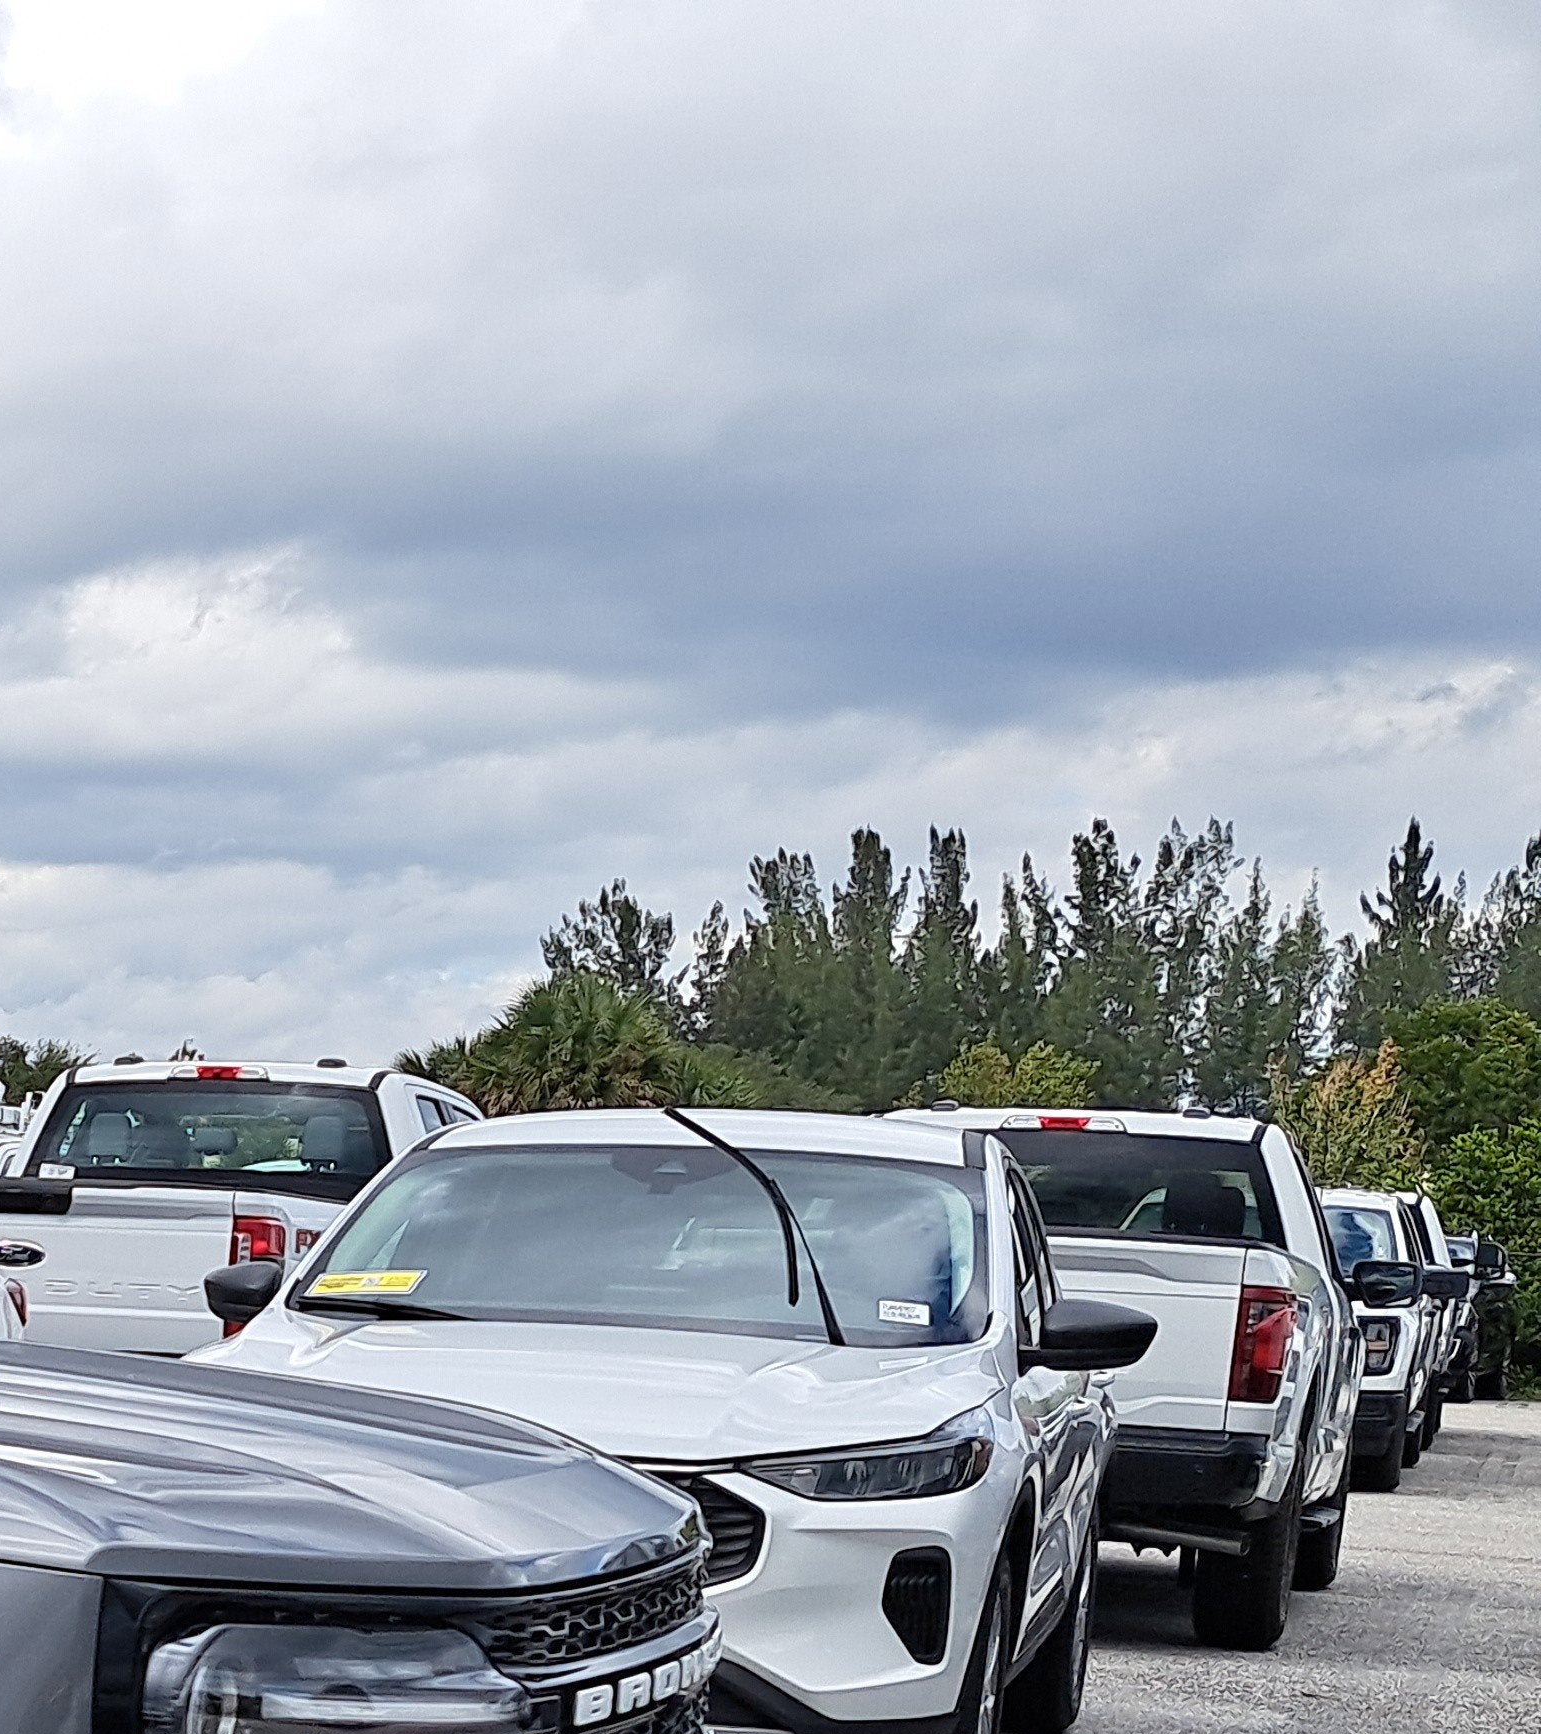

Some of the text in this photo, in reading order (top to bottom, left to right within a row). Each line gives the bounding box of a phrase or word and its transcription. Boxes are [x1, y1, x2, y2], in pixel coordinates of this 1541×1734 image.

[294, 1228, 322, 1254] FX
[44, 1279, 201, 1301] DUTY
[573, 1626, 723, 1727] BRON
